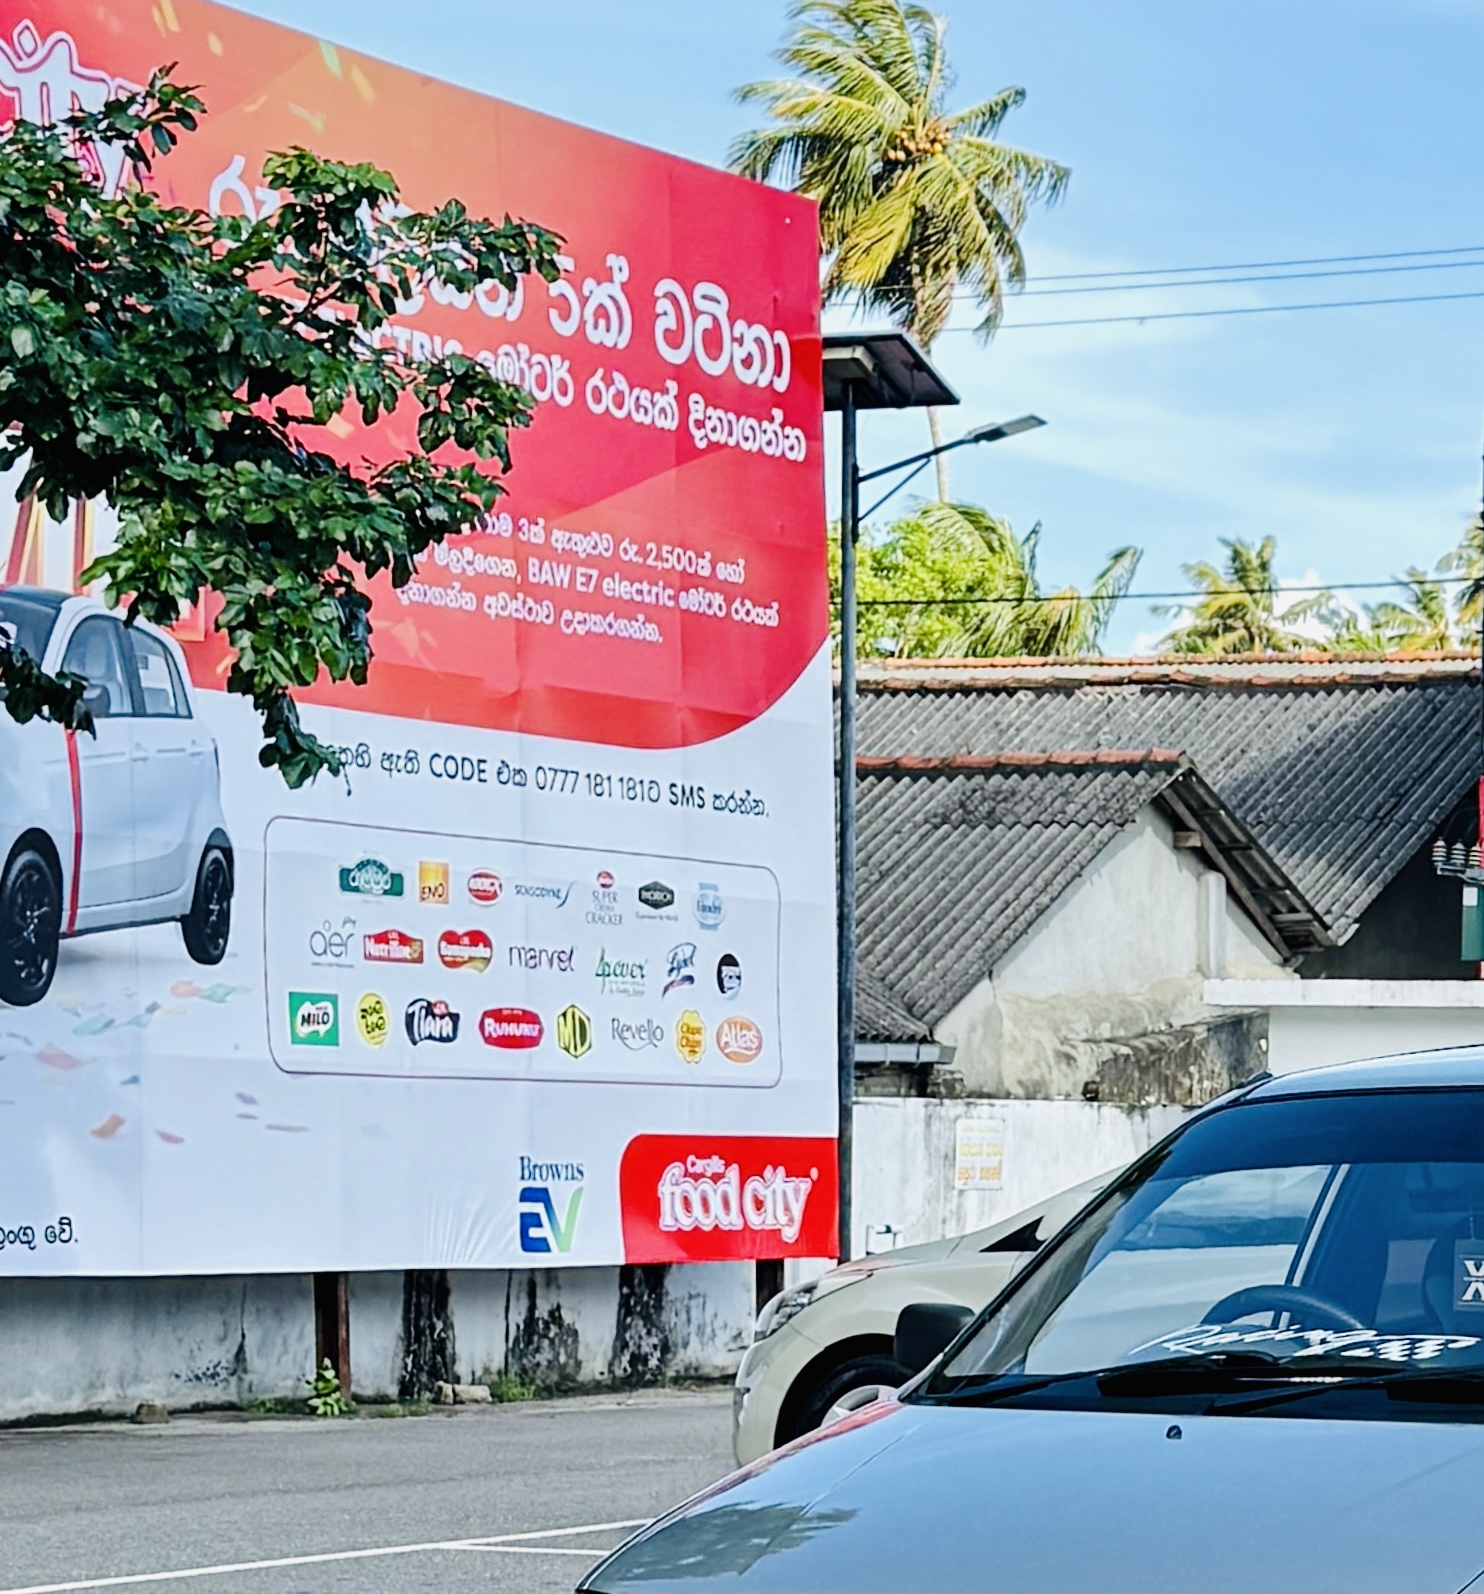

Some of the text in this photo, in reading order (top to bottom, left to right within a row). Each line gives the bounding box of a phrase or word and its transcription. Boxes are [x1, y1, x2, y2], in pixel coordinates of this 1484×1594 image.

[654, 278, 792, 394] වටිනා
[687, 392, 808, 463] දිනාගන්න
[528, 556, 572, 589] BAW
[575, 566, 599, 594] E7
[602, 572, 675, 607] electric
[380, 749, 420, 778] ඇති
[429, 753, 488, 783] CODE
[497, 760, 528, 787] එක
[535, 765, 580, 794] 0777
[585, 772, 612, 798] 181
[669, 782, 706, 809] SMS
[300, 1011, 330, 1027] MILO
[558, 1008, 592, 1057] MD
[519, 1156, 584, 1182] Browns
[519, 1187, 584, 1253] EV
[658, 1161, 812, 1244] food city
